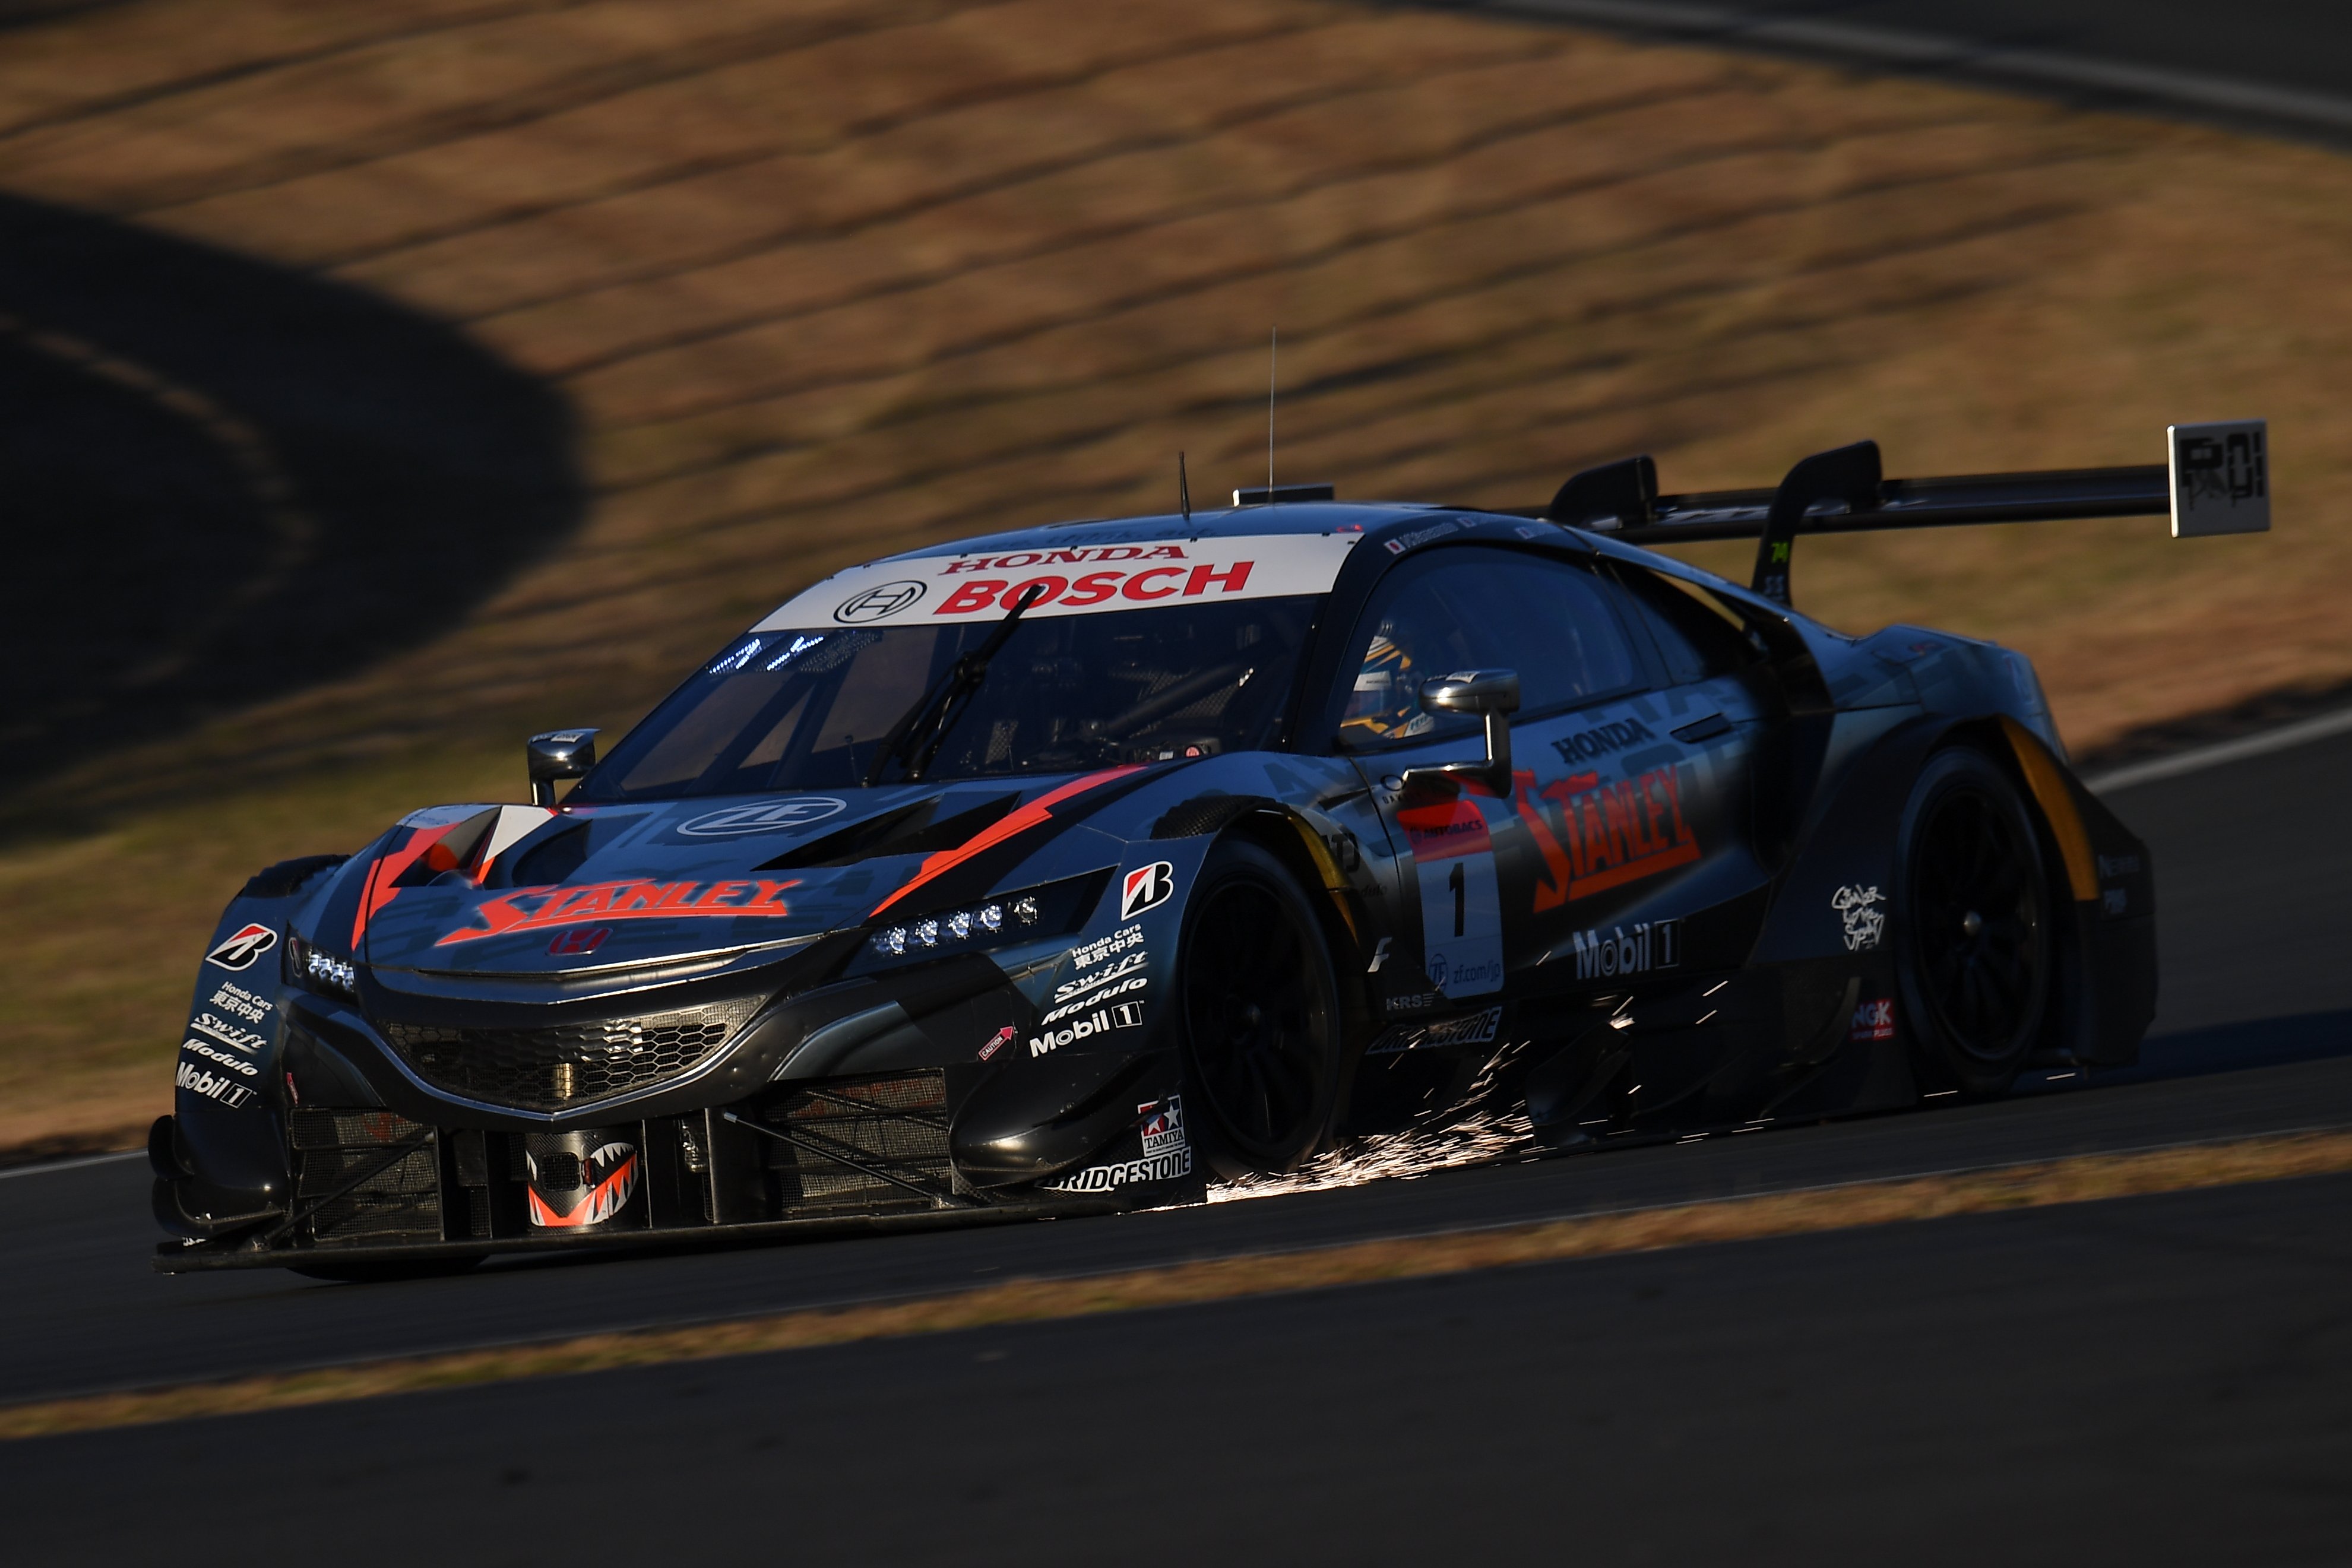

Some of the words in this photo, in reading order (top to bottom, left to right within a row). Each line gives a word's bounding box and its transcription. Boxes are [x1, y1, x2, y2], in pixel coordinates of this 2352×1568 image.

[938, 545, 1189, 575] HONDA
[933, 562, 1254, 615] BOSCH
[1551, 717, 1657, 765] HONDA
[1423, 819, 1483, 840] AUTOBACS
[1512, 765, 1702, 914] STANLEY
[434, 876, 803, 946] STANLEY
[1449, 863, 1464, 937] 1
[1071, 935, 1112, 958] Honda
[1114, 923, 1141, 939] Cars
[1074, 933, 1145, 970] 東京中央
[1572, 922, 1651, 980] Mobil
[1053, 950, 1149, 1000] Swift
[1454, 959, 1500, 984] zf.com/jp
[209, 990, 265, 1024] 東京中央
[221, 981, 252, 1000] Honda
[252, 997, 273, 1011] Cars
[1041, 977, 1148, 1026] Modulo
[194, 1012, 267, 1049] Swift
[1029, 1009, 1110, 1059] Mobil
[1851, 1002, 1892, 1029] NGK
[182, 1038, 259, 1076] Modulo
[982, 1035, 1003, 1057] CAUTION
[176, 1061, 232, 1099] Mobil
[1144, 1128, 1184, 1149] TAMIYA
